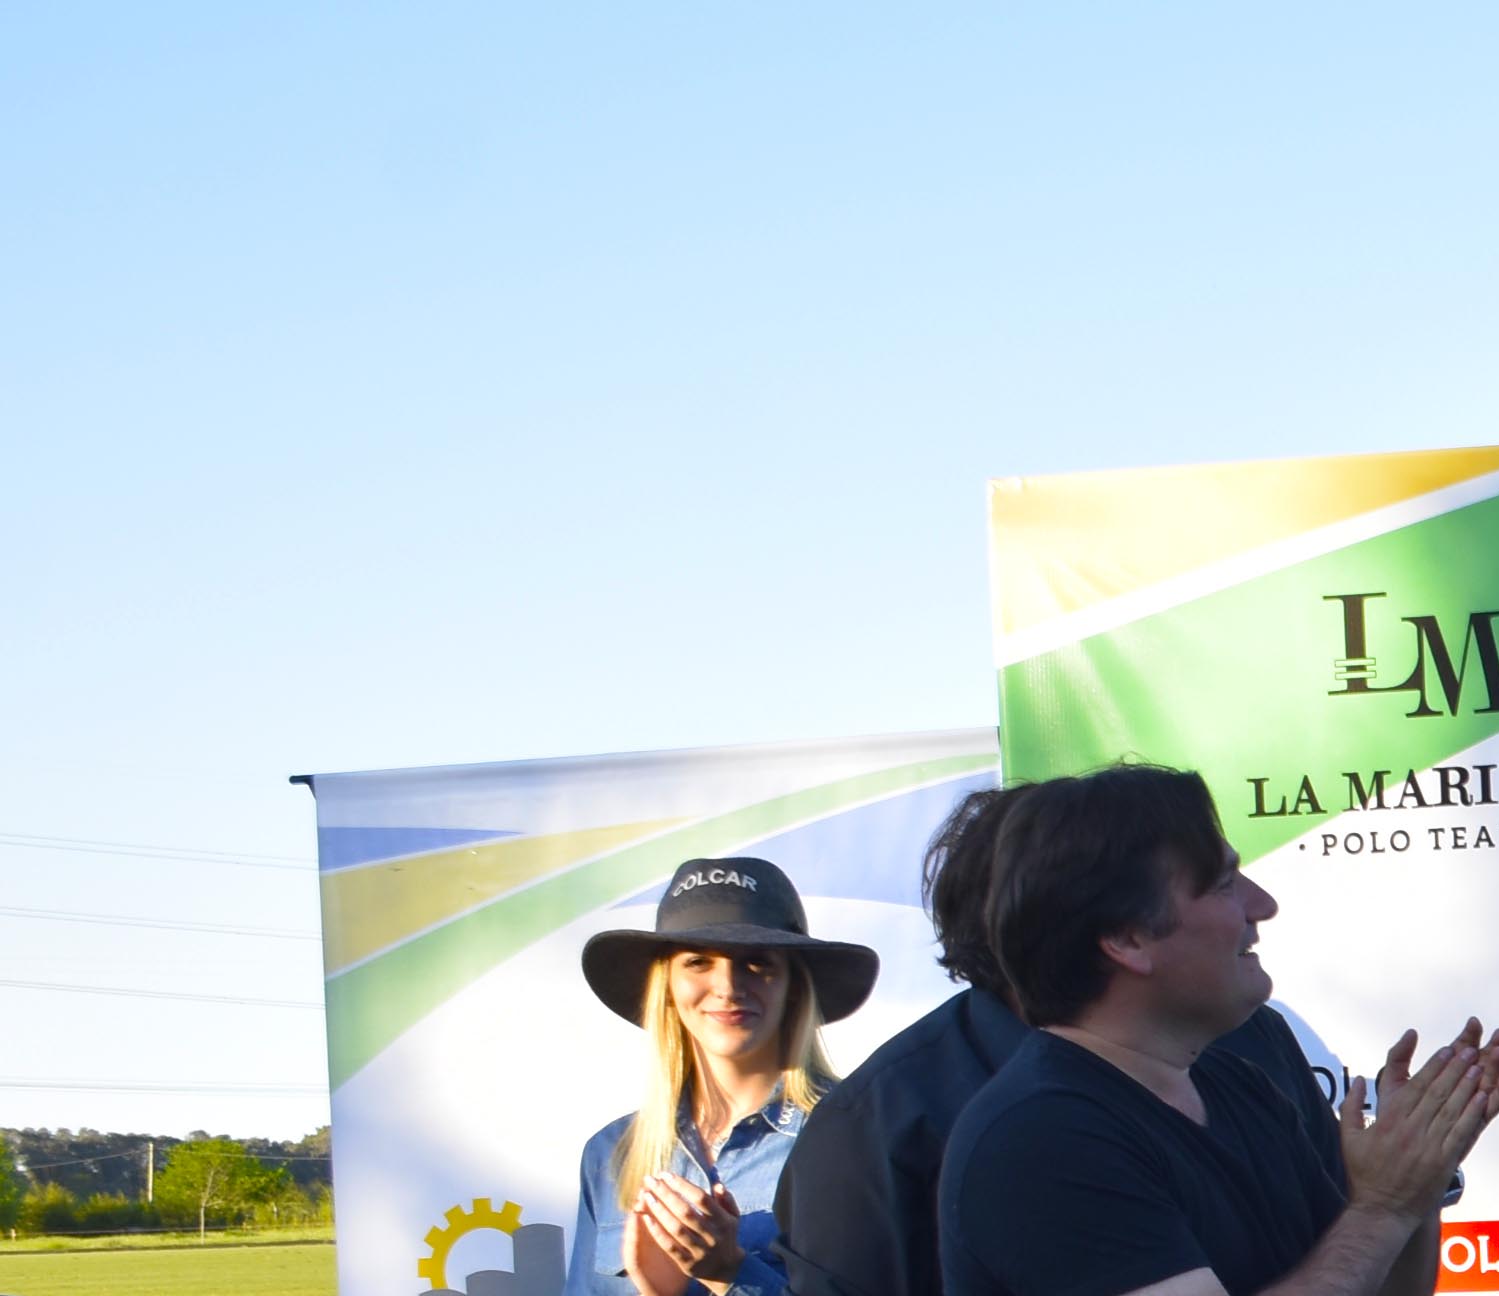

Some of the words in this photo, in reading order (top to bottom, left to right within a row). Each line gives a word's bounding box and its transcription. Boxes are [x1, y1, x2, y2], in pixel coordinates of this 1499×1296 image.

[1247, 775, 1324, 819] LA
[1321, 829, 1412, 857] POLO
[672, 868, 758, 899] COLCAR
